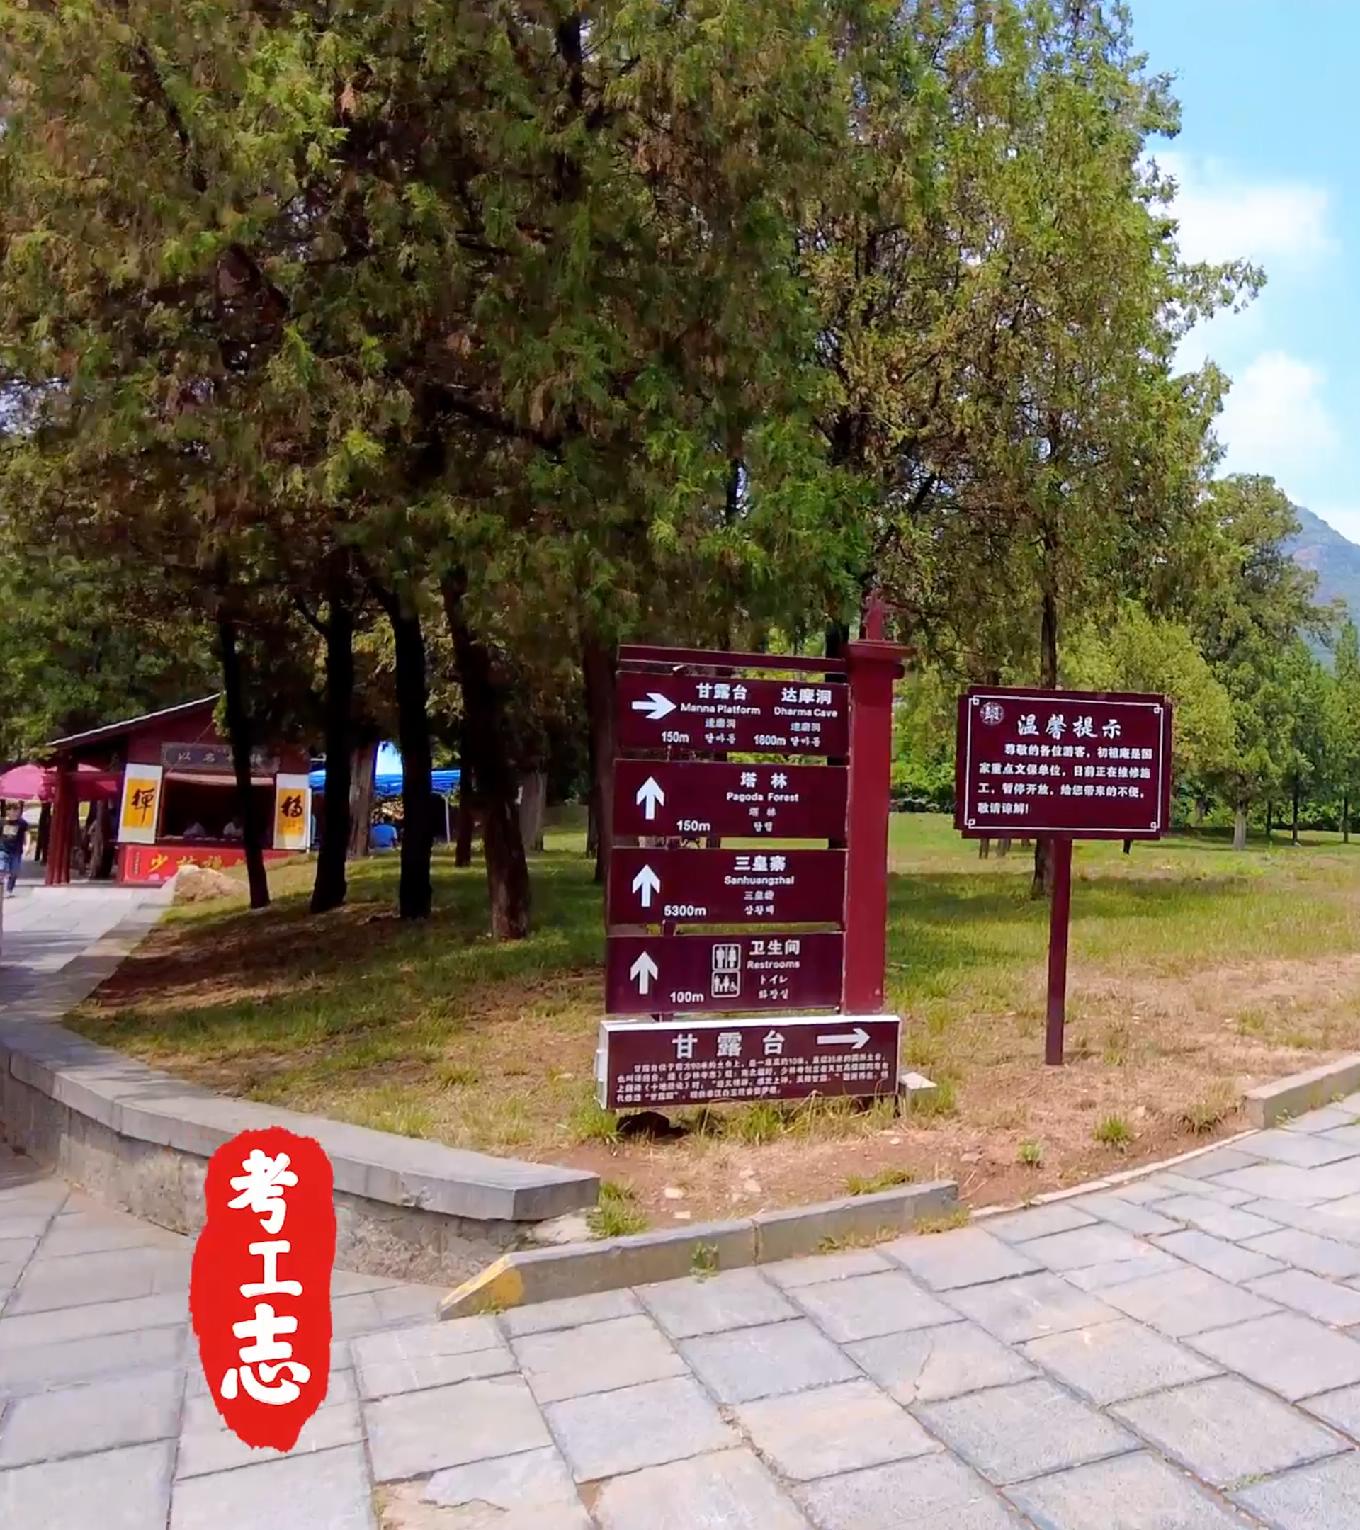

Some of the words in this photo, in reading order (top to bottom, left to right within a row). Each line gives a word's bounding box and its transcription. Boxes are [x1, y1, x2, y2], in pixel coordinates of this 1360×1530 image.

[696, 683, 748, 701] 甘露台
[780, 687, 833, 705] 达摩洞
[680, 703, 716, 714] Manna
[717, 704, 761, 716] Platform
[773, 707, 812, 718] Dharma
[813, 708, 838, 719] Cave
[1016, 713, 1122, 740] 温馨提示
[661, 731, 690, 744] 150m
[740, 772, 788, 789] 塔林
[726, 792, 764, 803] Pagoda
[768, 792, 799, 803] Forest
[676, 820, 711, 832] 150m
[734, 855, 786, 872] 三皇寨
[724, 874, 795, 886] Sanhuangzhai
[749, 940, 800, 956] 卫生间
[747, 960, 800, 970] Restrooms
[760, 974, 788, 986] トイレ
[669, 991, 704, 1003] 100m
[672, 1030, 785, 1059] 甘露台
